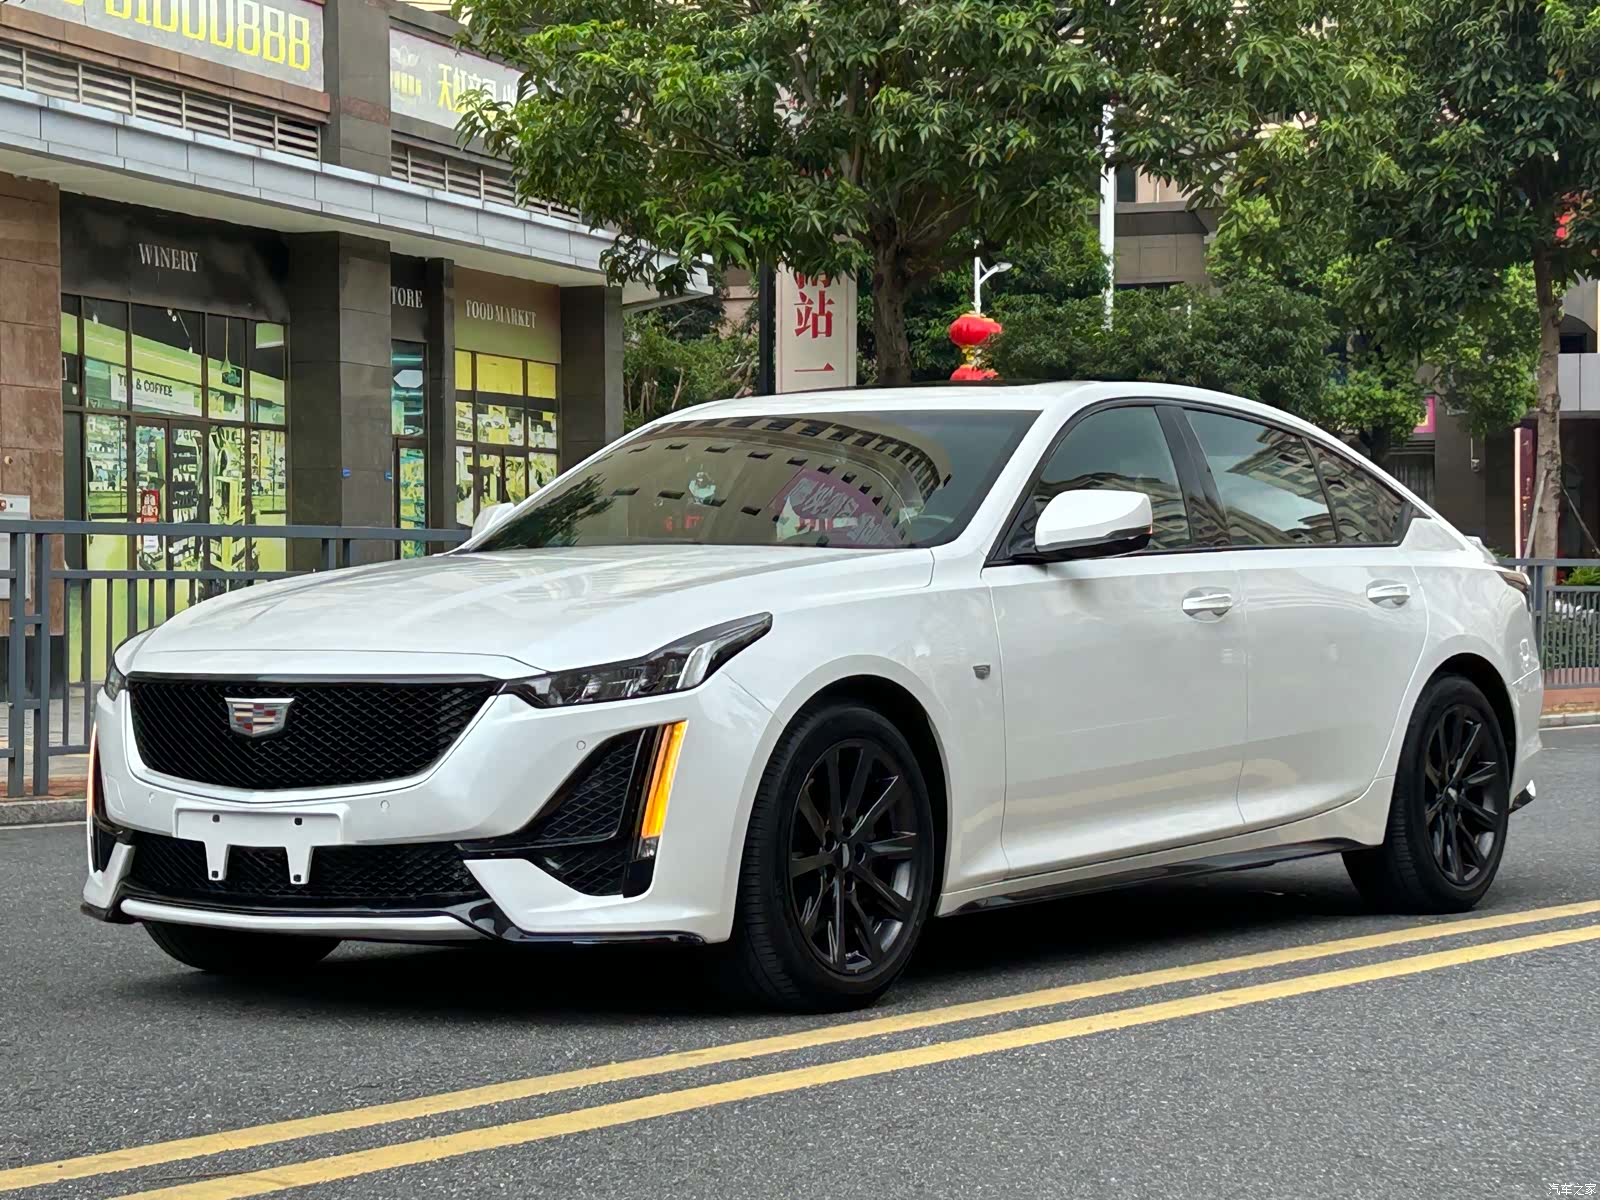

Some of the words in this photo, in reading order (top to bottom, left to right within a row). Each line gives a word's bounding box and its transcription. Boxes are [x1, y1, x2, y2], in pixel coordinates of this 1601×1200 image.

[138, 243, 199, 272] WINERY
[466, 299, 494, 321] FOOD
[495, 305, 537, 329] MARKET
[144, 380, 173, 397] COFFEE
